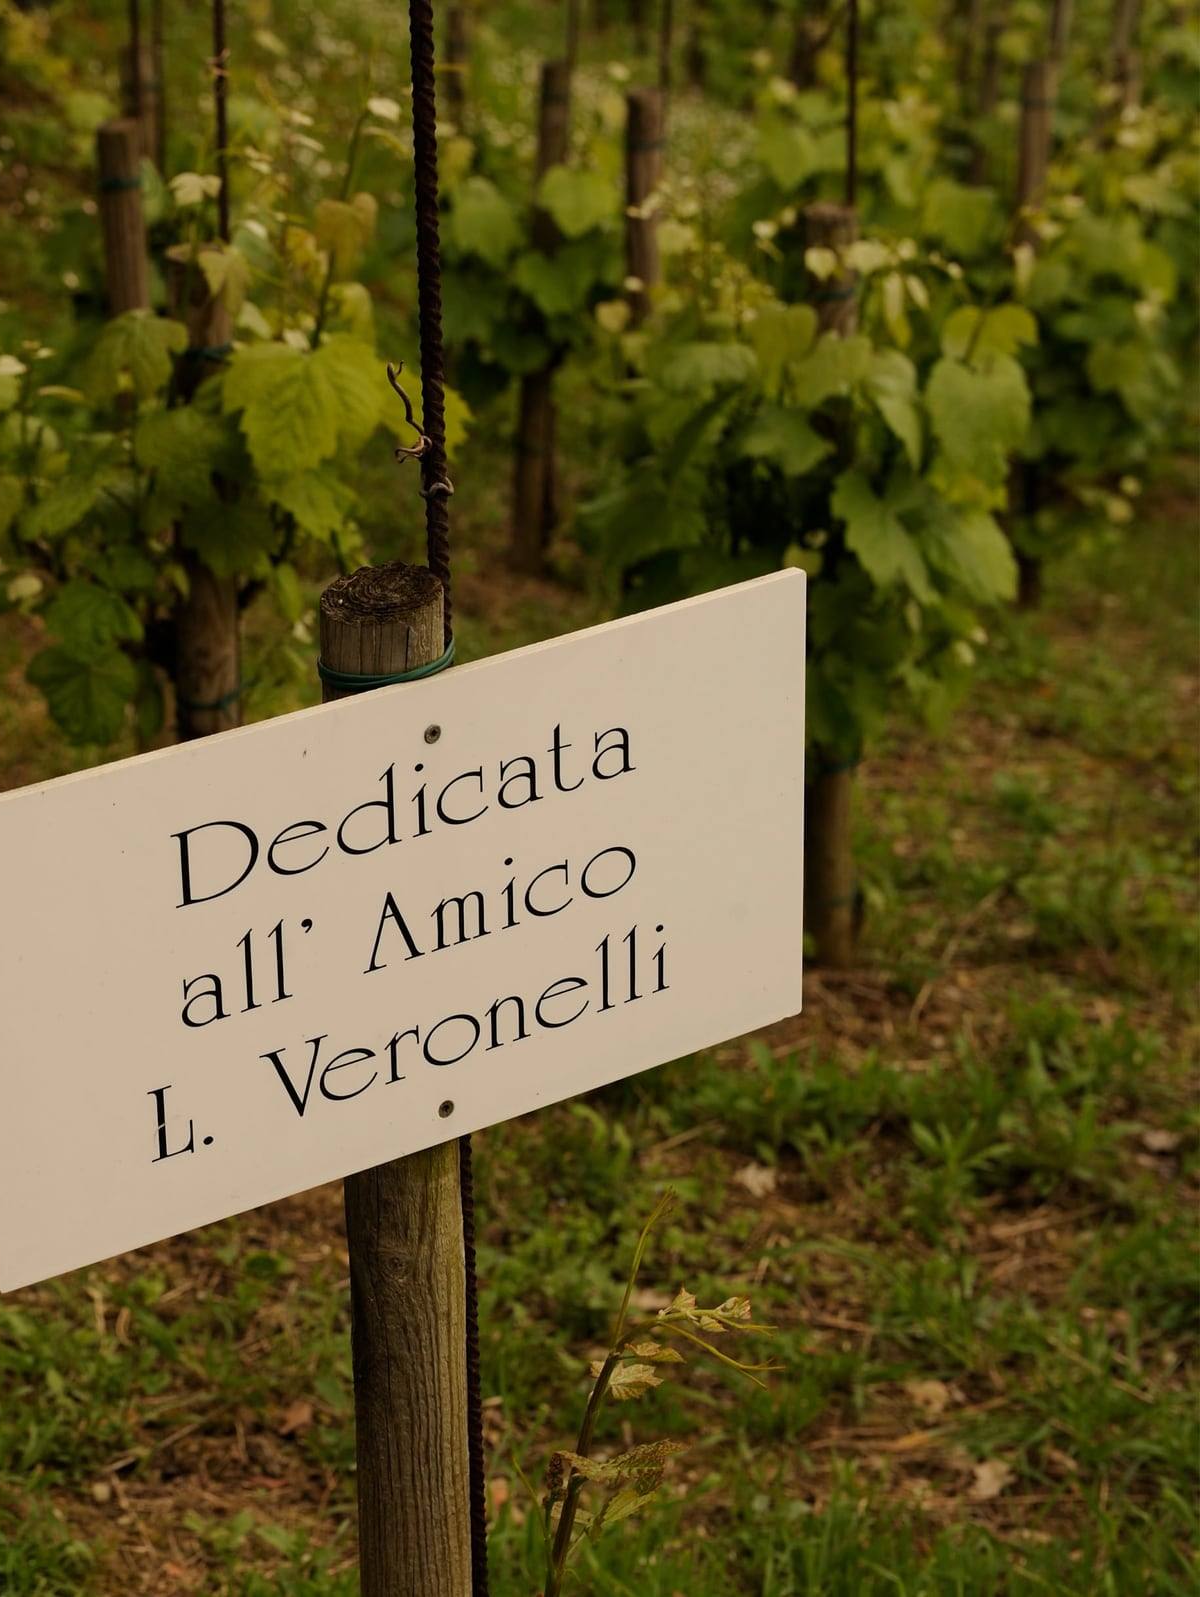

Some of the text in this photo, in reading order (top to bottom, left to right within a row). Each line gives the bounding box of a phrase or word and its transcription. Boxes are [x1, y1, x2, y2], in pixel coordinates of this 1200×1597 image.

[170, 723, 637, 909] Dedicata
[363, 846, 637, 975] Amico
[146, 924, 670, 1163] L. Veronelli
